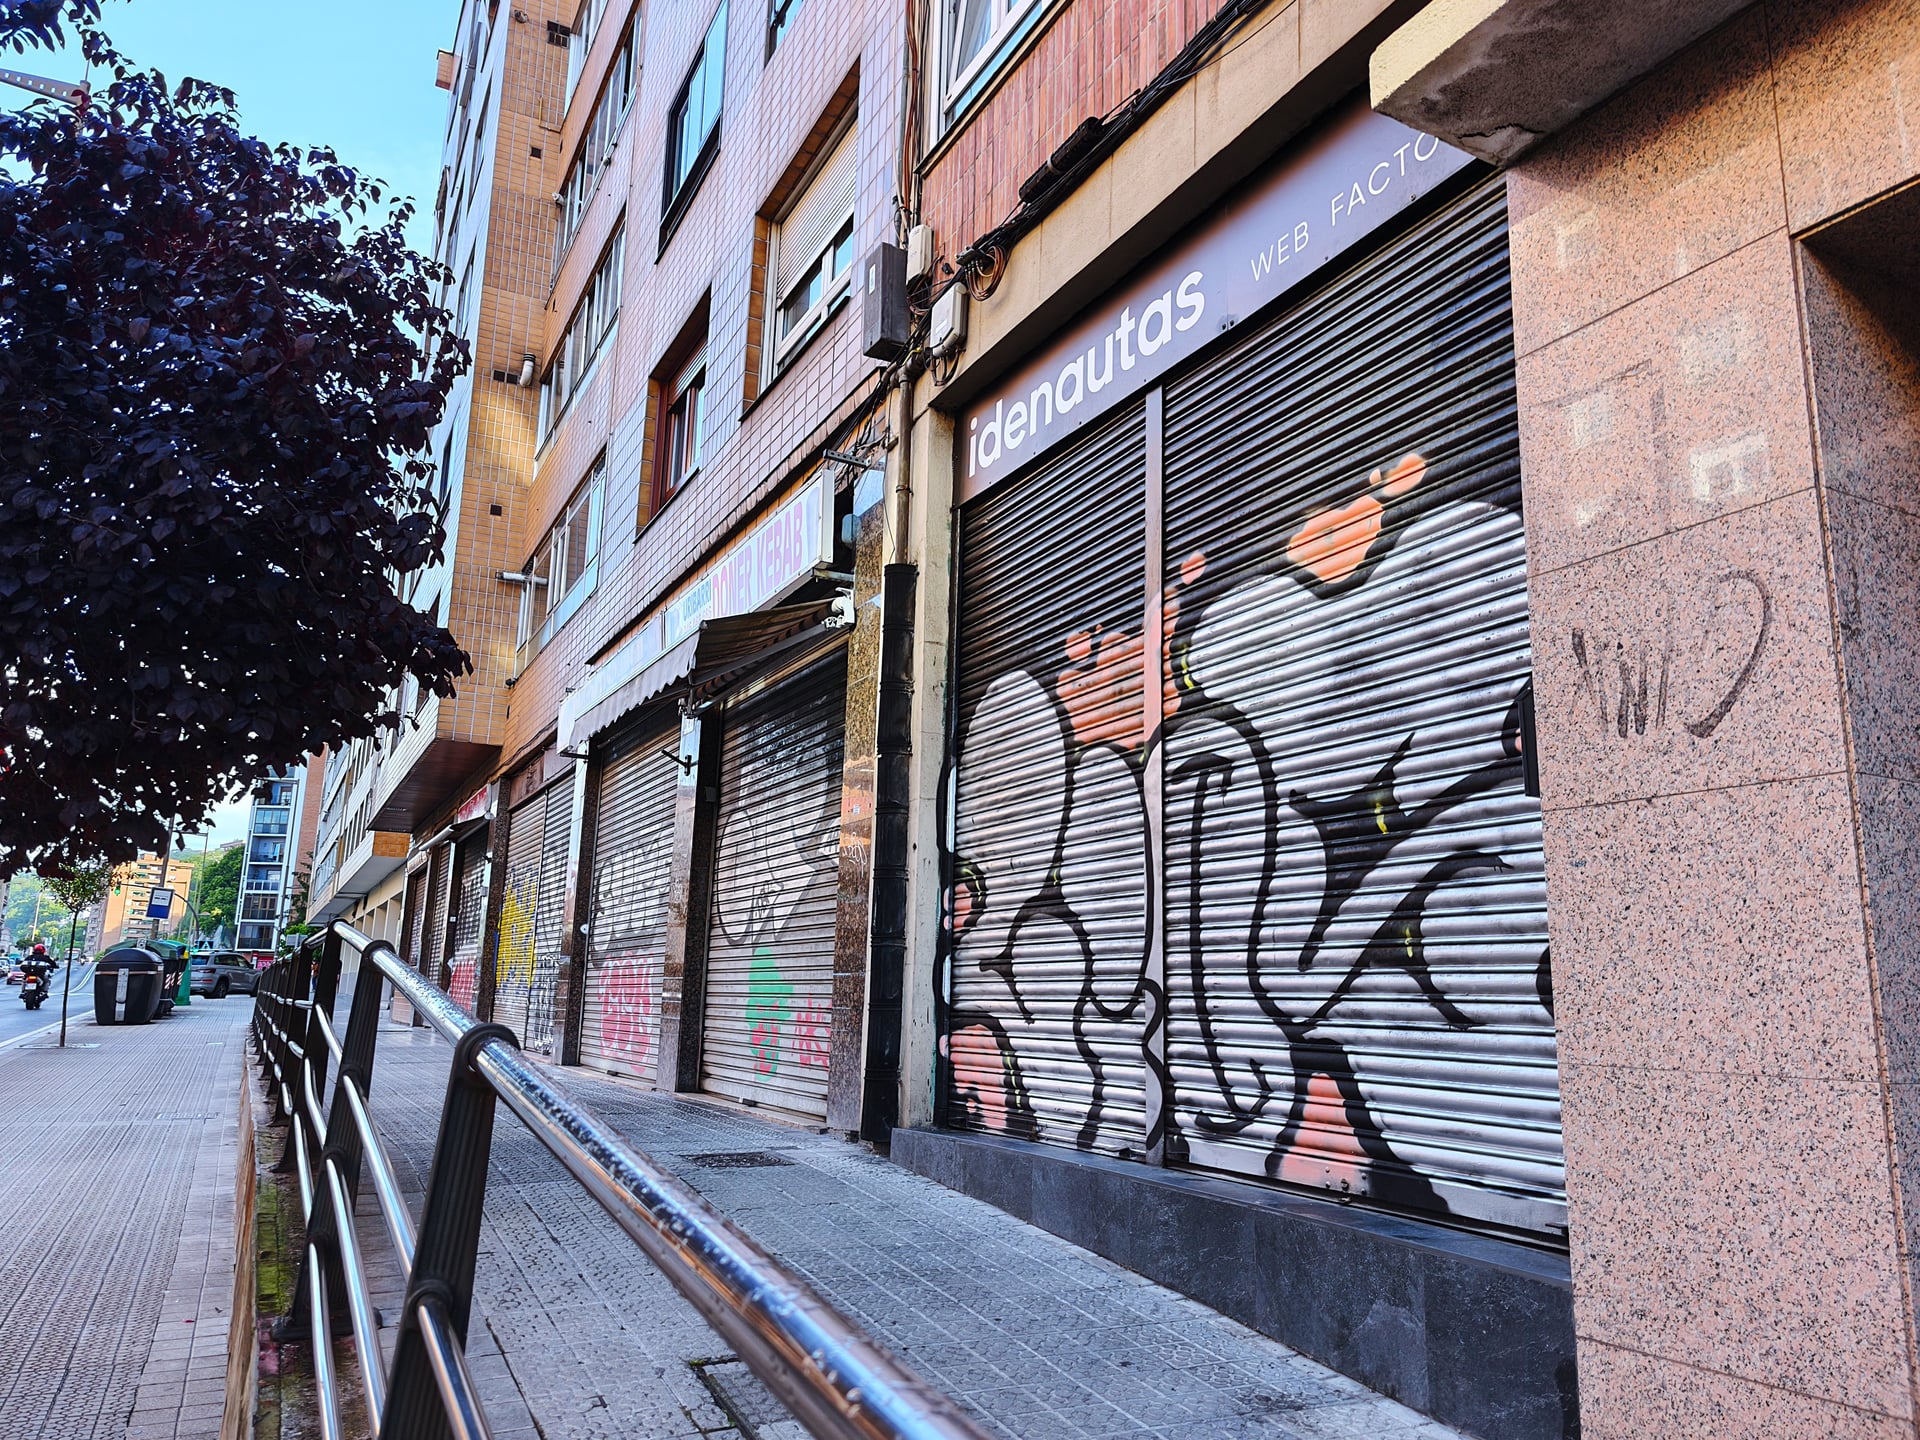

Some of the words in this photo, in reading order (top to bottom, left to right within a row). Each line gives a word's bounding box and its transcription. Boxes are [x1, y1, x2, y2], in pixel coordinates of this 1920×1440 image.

[1250, 221, 1310, 281] WEB
[968, 271, 1205, 478] idenautas
[756, 501, 803, 599] KEBAB
